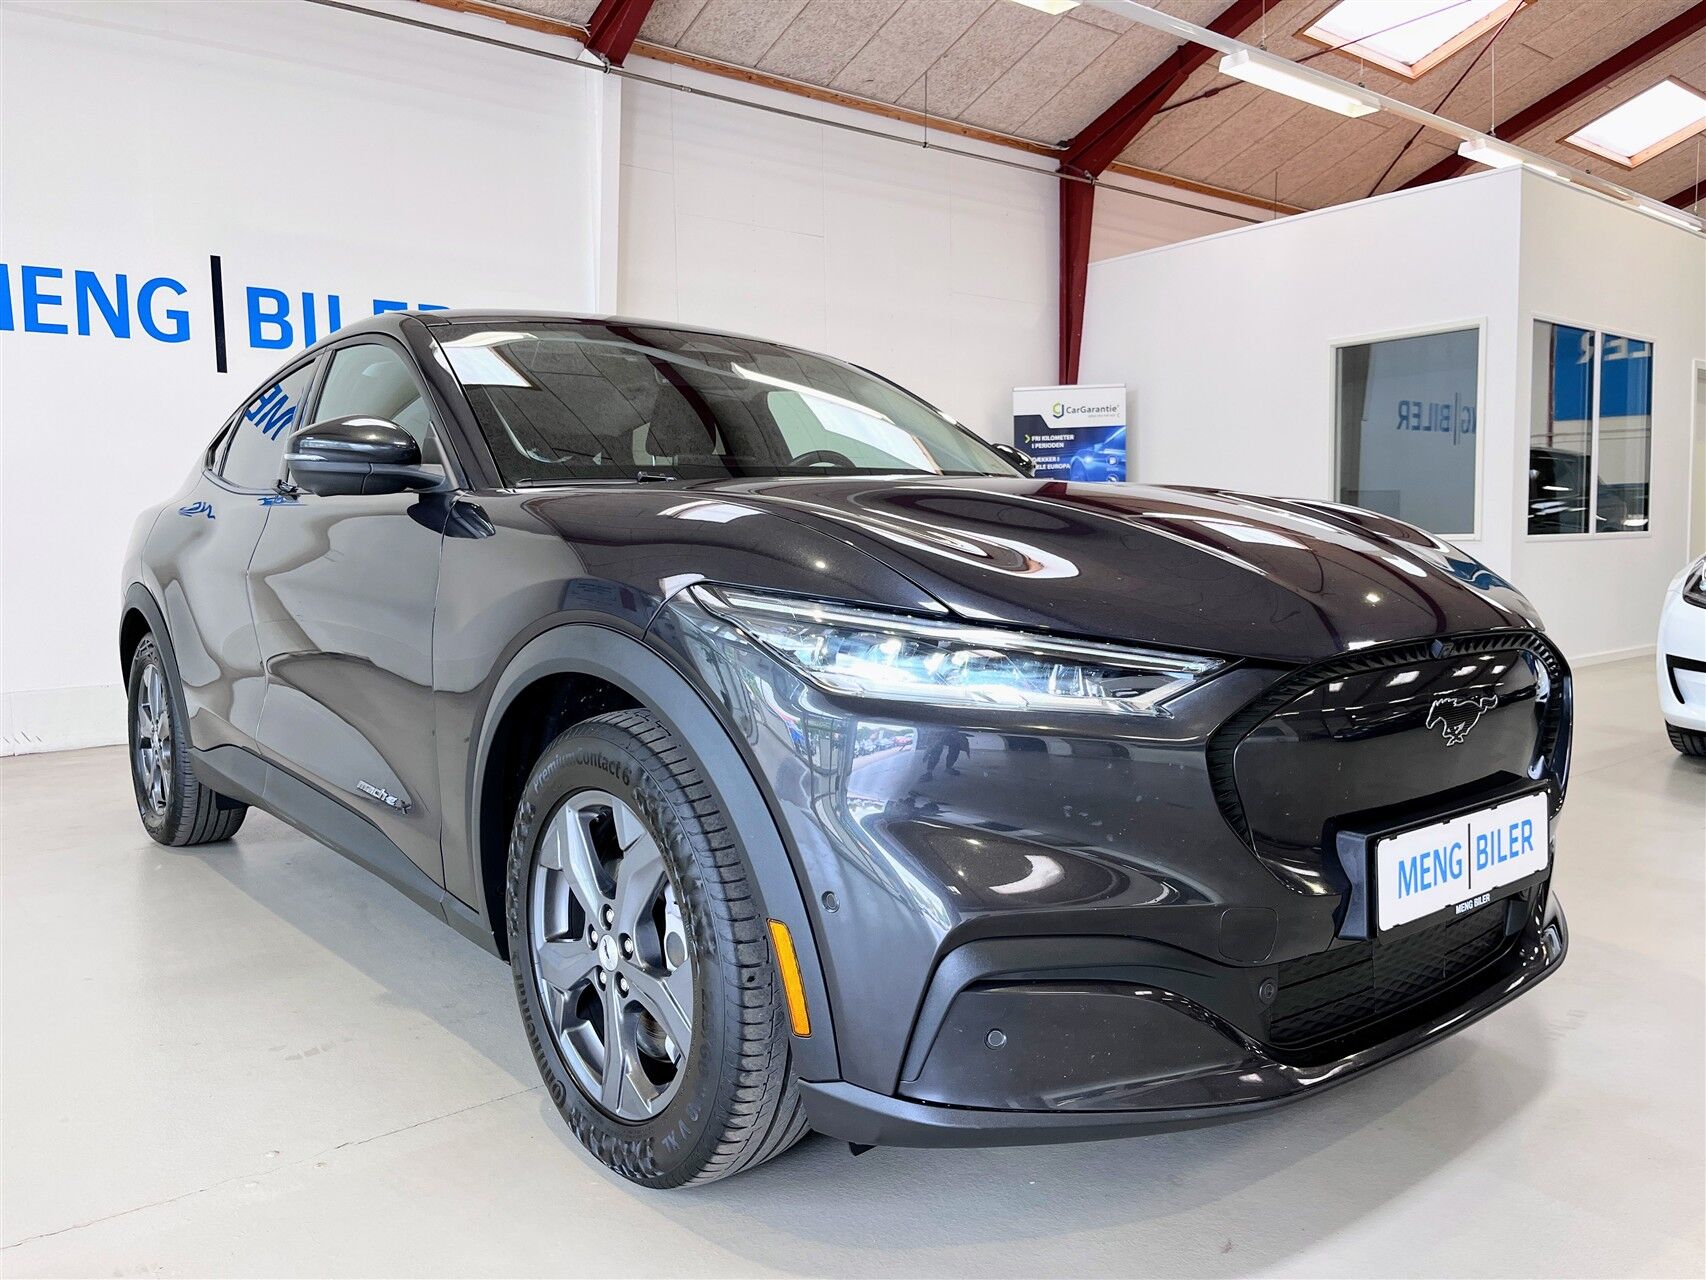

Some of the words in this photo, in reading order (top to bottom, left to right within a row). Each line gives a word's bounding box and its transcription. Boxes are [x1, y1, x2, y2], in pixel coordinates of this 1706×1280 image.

[1066, 404, 1118, 414] CarGarantie
[622, 766, 632, 786] 6
[1398, 842, 1462, 899] MENG
[1476, 818, 1534, 871] BILER
[1455, 901, 1474, 915] MENG
[1473, 892, 1491, 909] BILER
